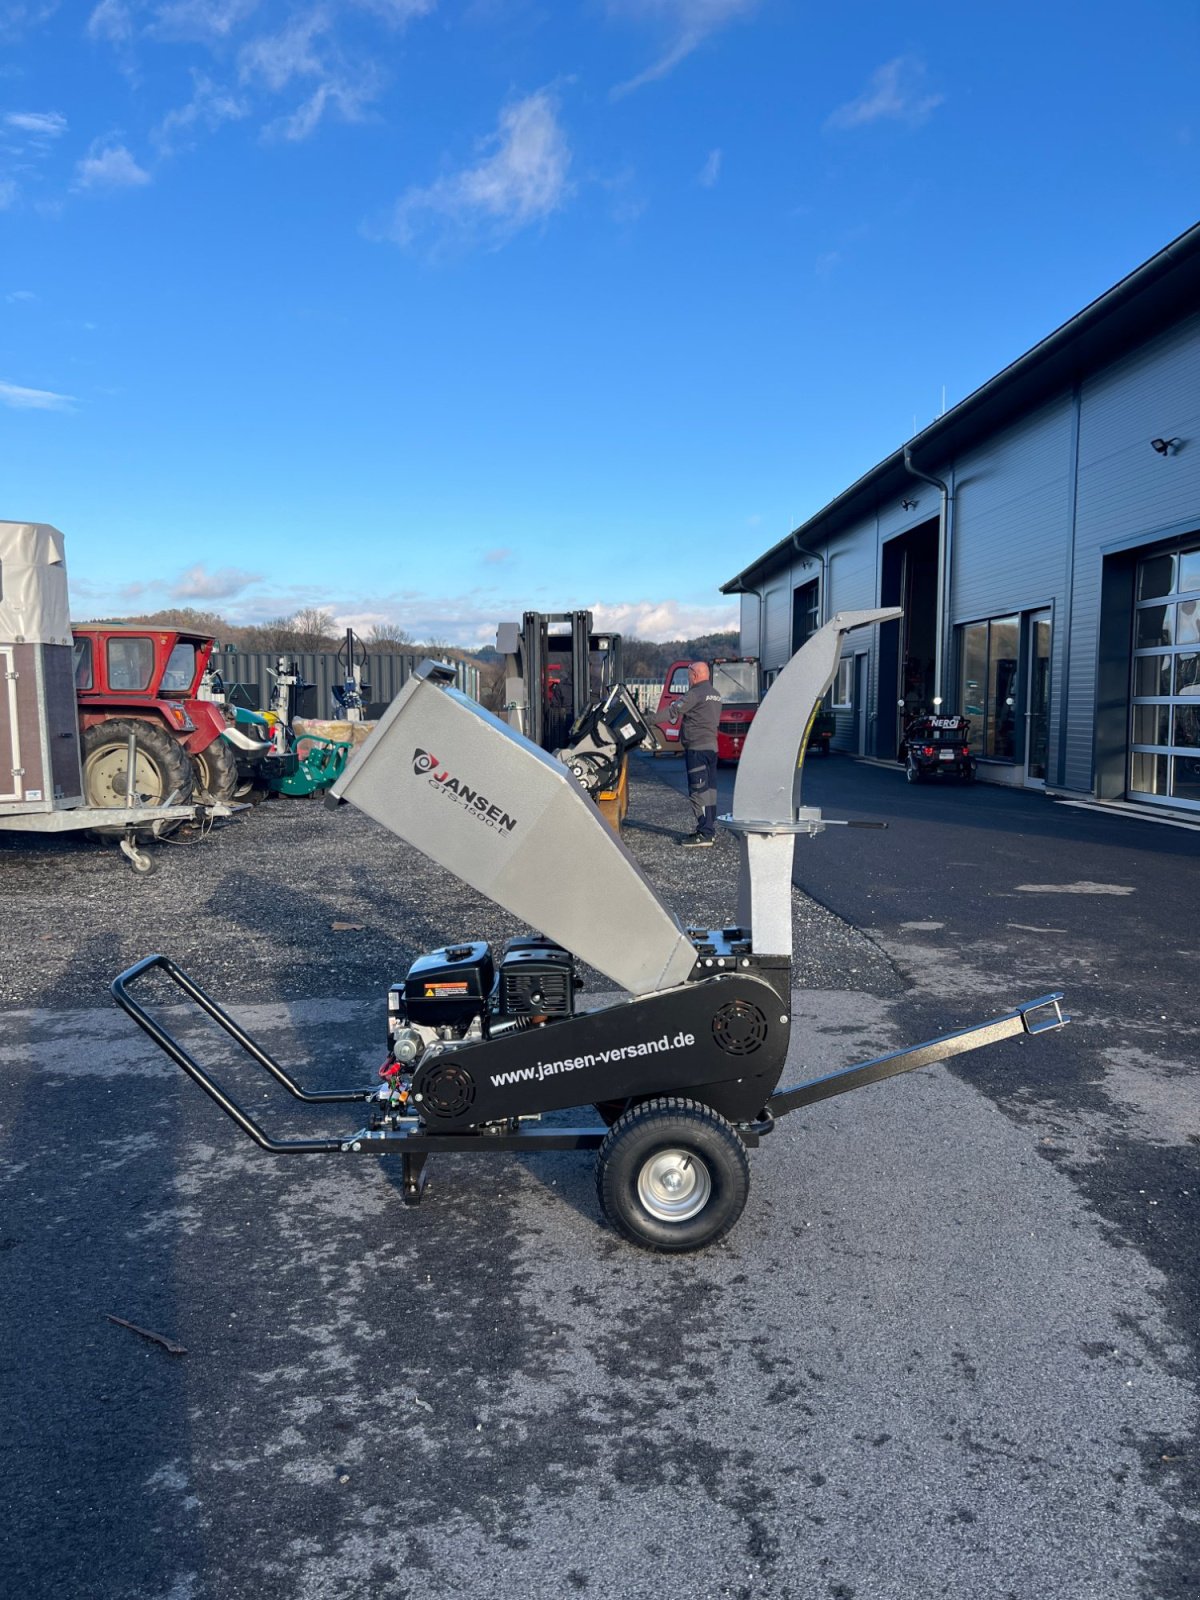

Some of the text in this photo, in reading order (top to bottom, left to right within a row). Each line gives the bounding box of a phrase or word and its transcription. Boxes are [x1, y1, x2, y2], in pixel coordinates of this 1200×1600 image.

[931, 719, 958, 728] NERO
[433, 771, 517, 831] JANSEN
[490, 1032, 695, 1087] www.jansen-versand.de
